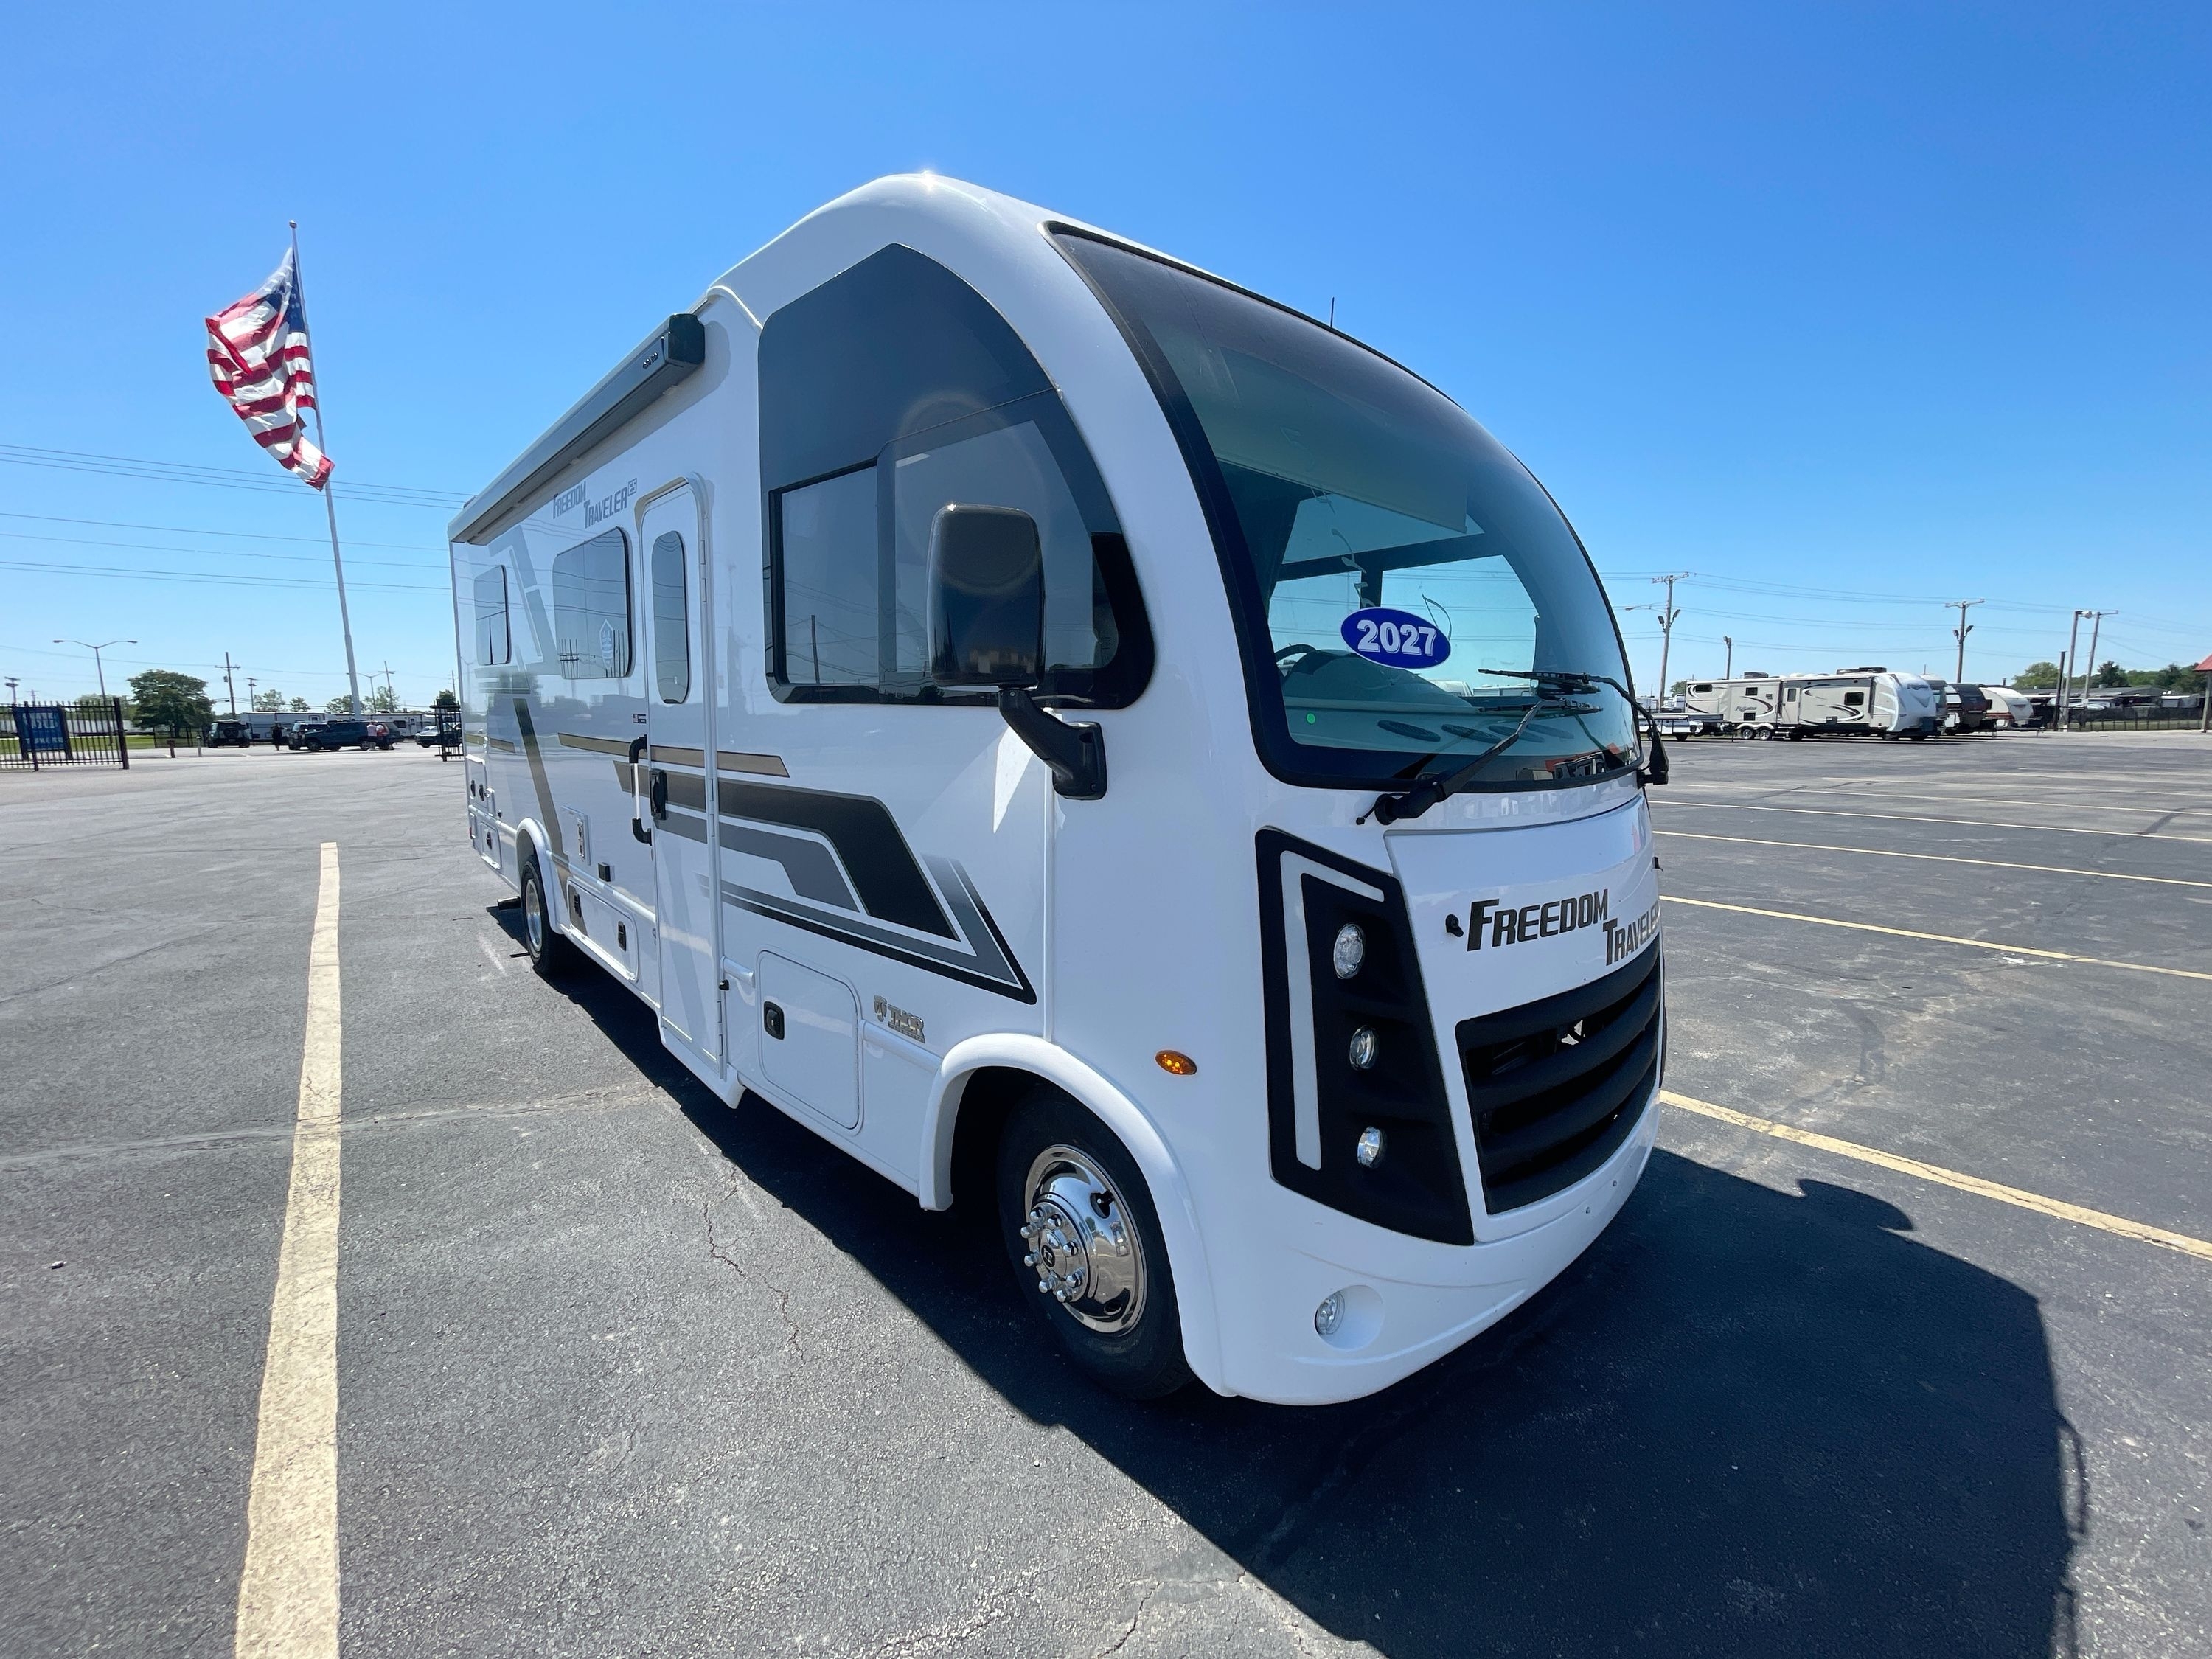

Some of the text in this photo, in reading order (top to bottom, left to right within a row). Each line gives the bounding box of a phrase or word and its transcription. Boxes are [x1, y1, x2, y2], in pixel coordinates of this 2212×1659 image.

[553, 481, 586, 520] FREEDOM
[584, 487, 627, 529] TRAVELER
[1357, 619, 1437, 656] 2027
[1467, 888, 1608, 951] FREEDOM
[1603, 902, 1658, 966] TRAVELE
